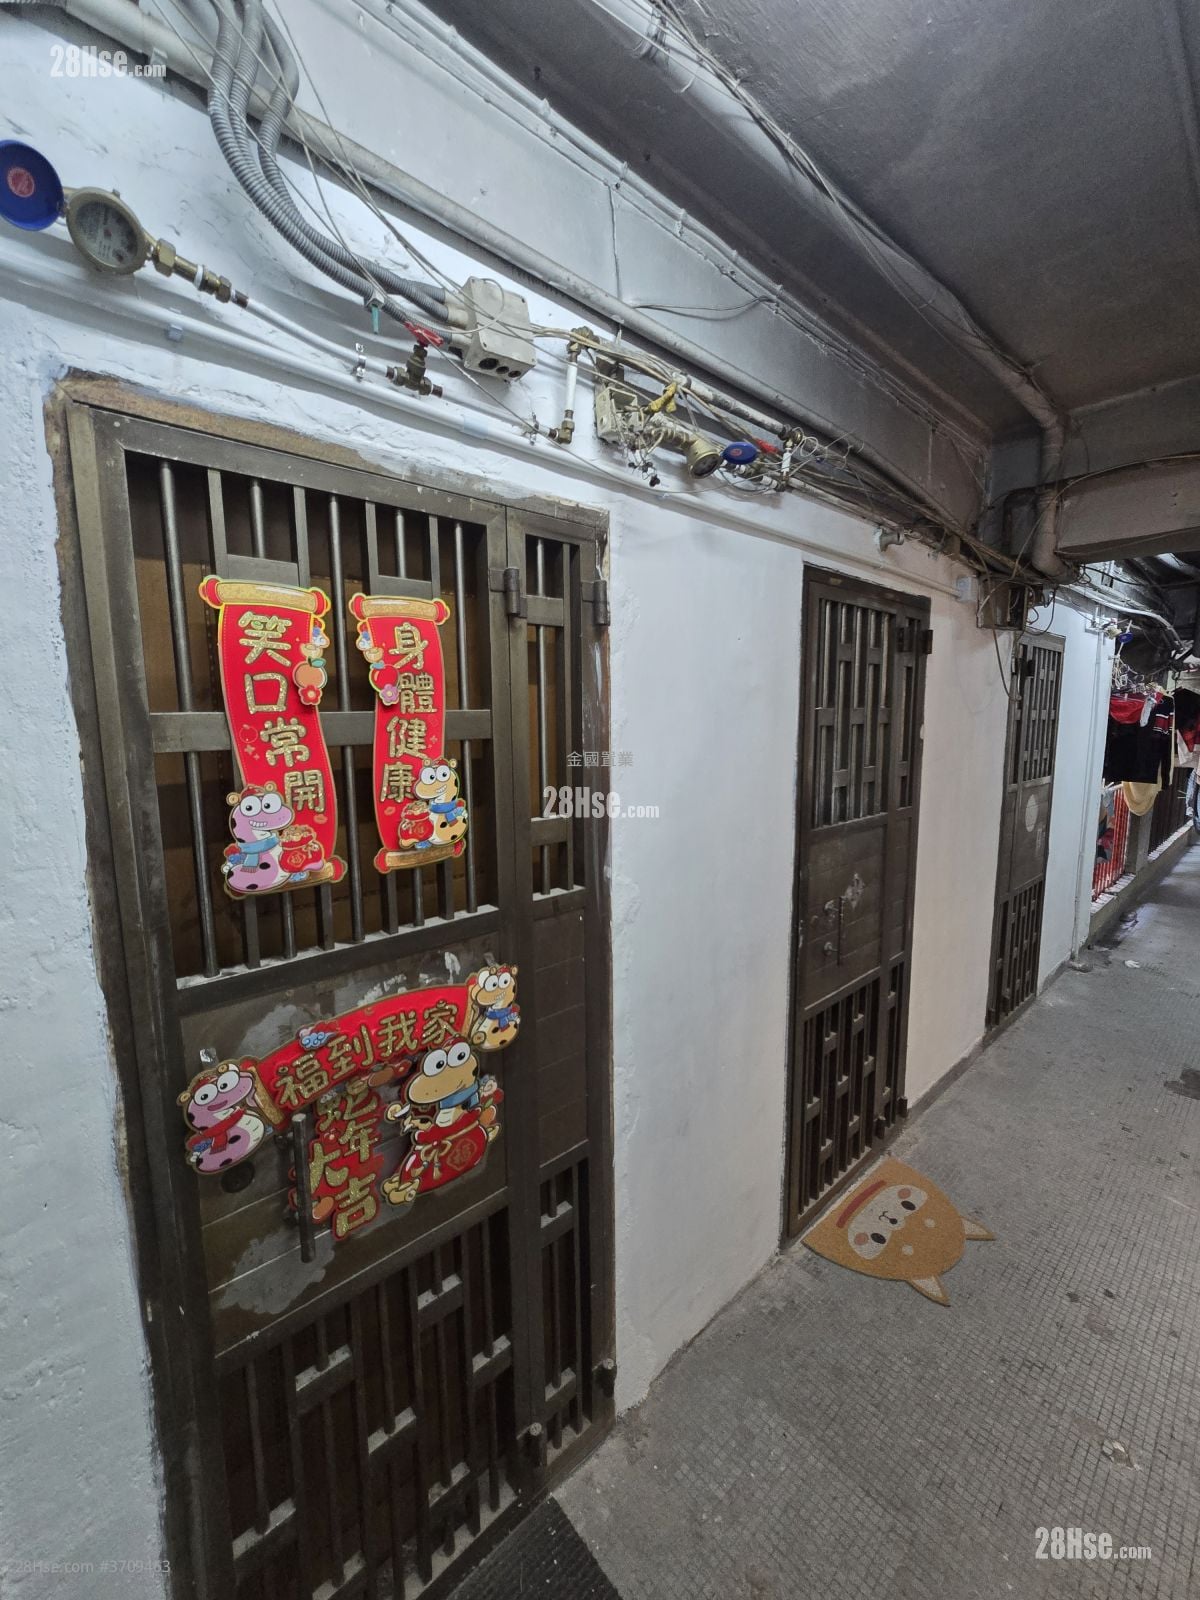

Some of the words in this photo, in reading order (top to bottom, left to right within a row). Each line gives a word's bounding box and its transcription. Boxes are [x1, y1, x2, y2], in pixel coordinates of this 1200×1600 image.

[237, 611, 324, 813] 笑口常開
[380, 622, 438, 804] 身體健康
[276, 1000, 459, 1107] 福到我家
